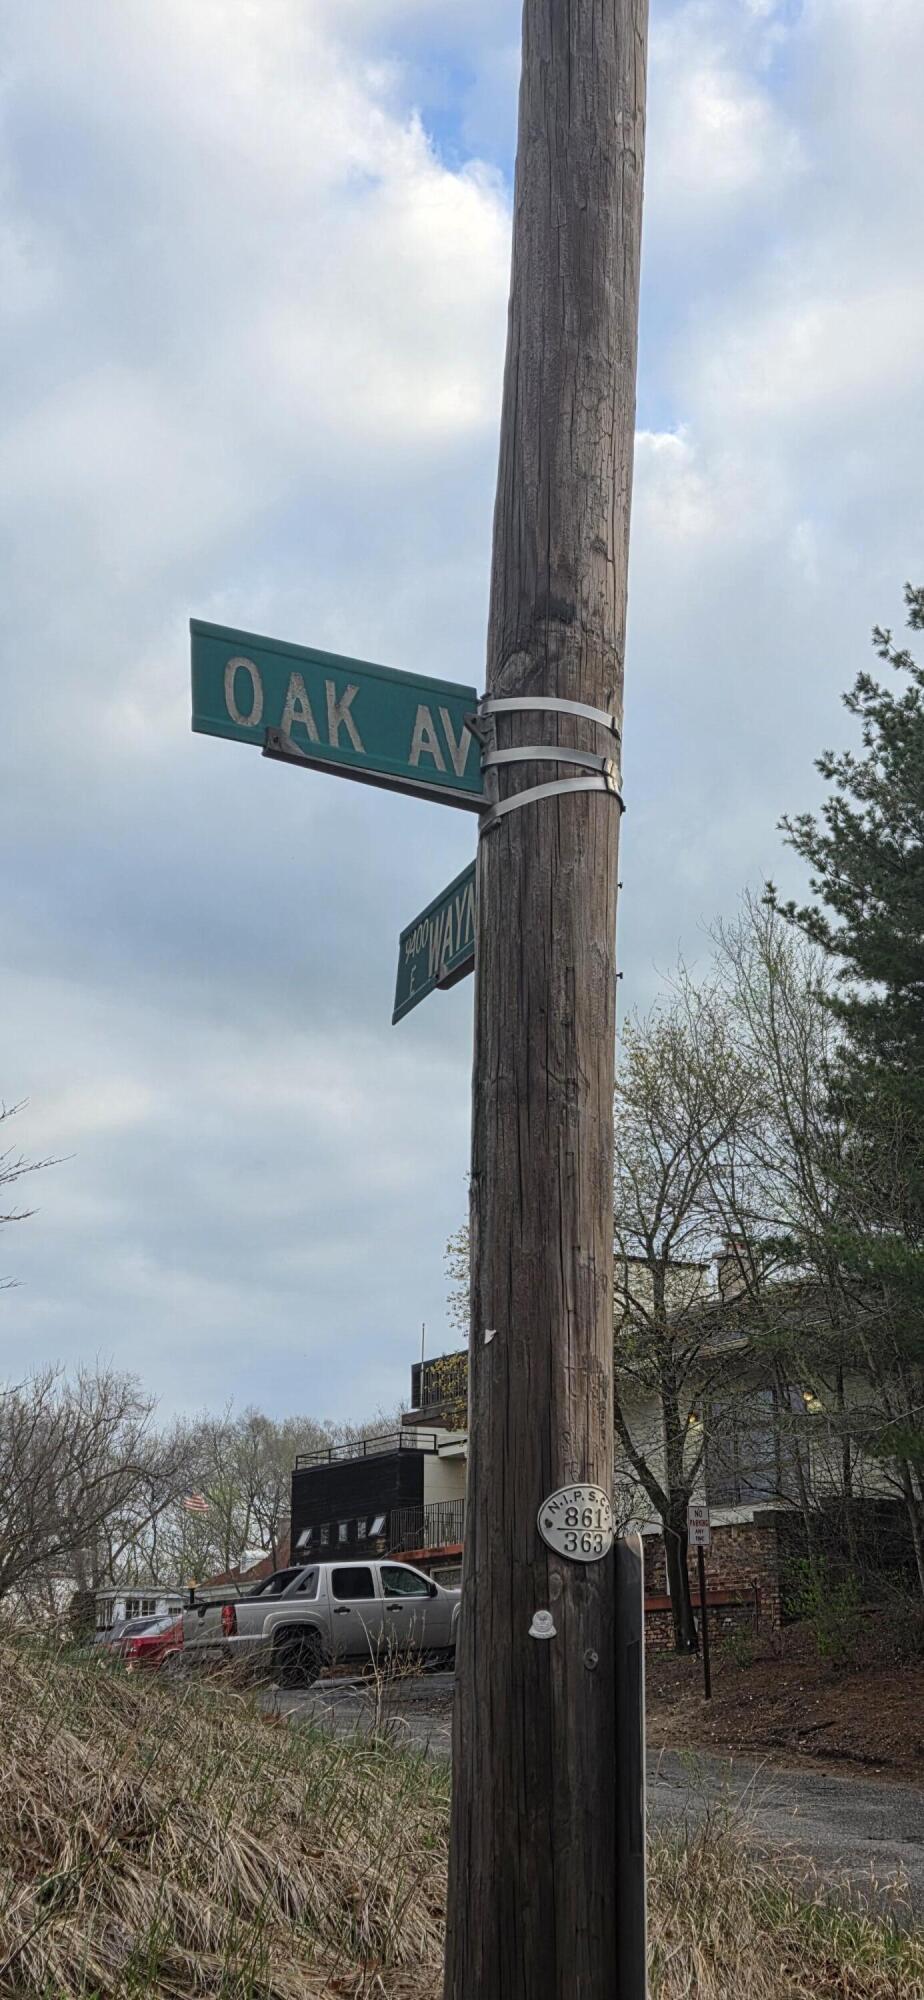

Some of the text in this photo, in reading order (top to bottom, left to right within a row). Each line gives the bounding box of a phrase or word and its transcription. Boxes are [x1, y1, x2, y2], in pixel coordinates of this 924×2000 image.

[224, 656, 472, 777] OAK AV
[409, 964, 417, 997] E
[565, 1506, 602, 1529] 861
[689, 1519, 709, 1527] PARKING
[694, 1510, 703, 1518] NO
[564, 1531, 603, 1553] 363
